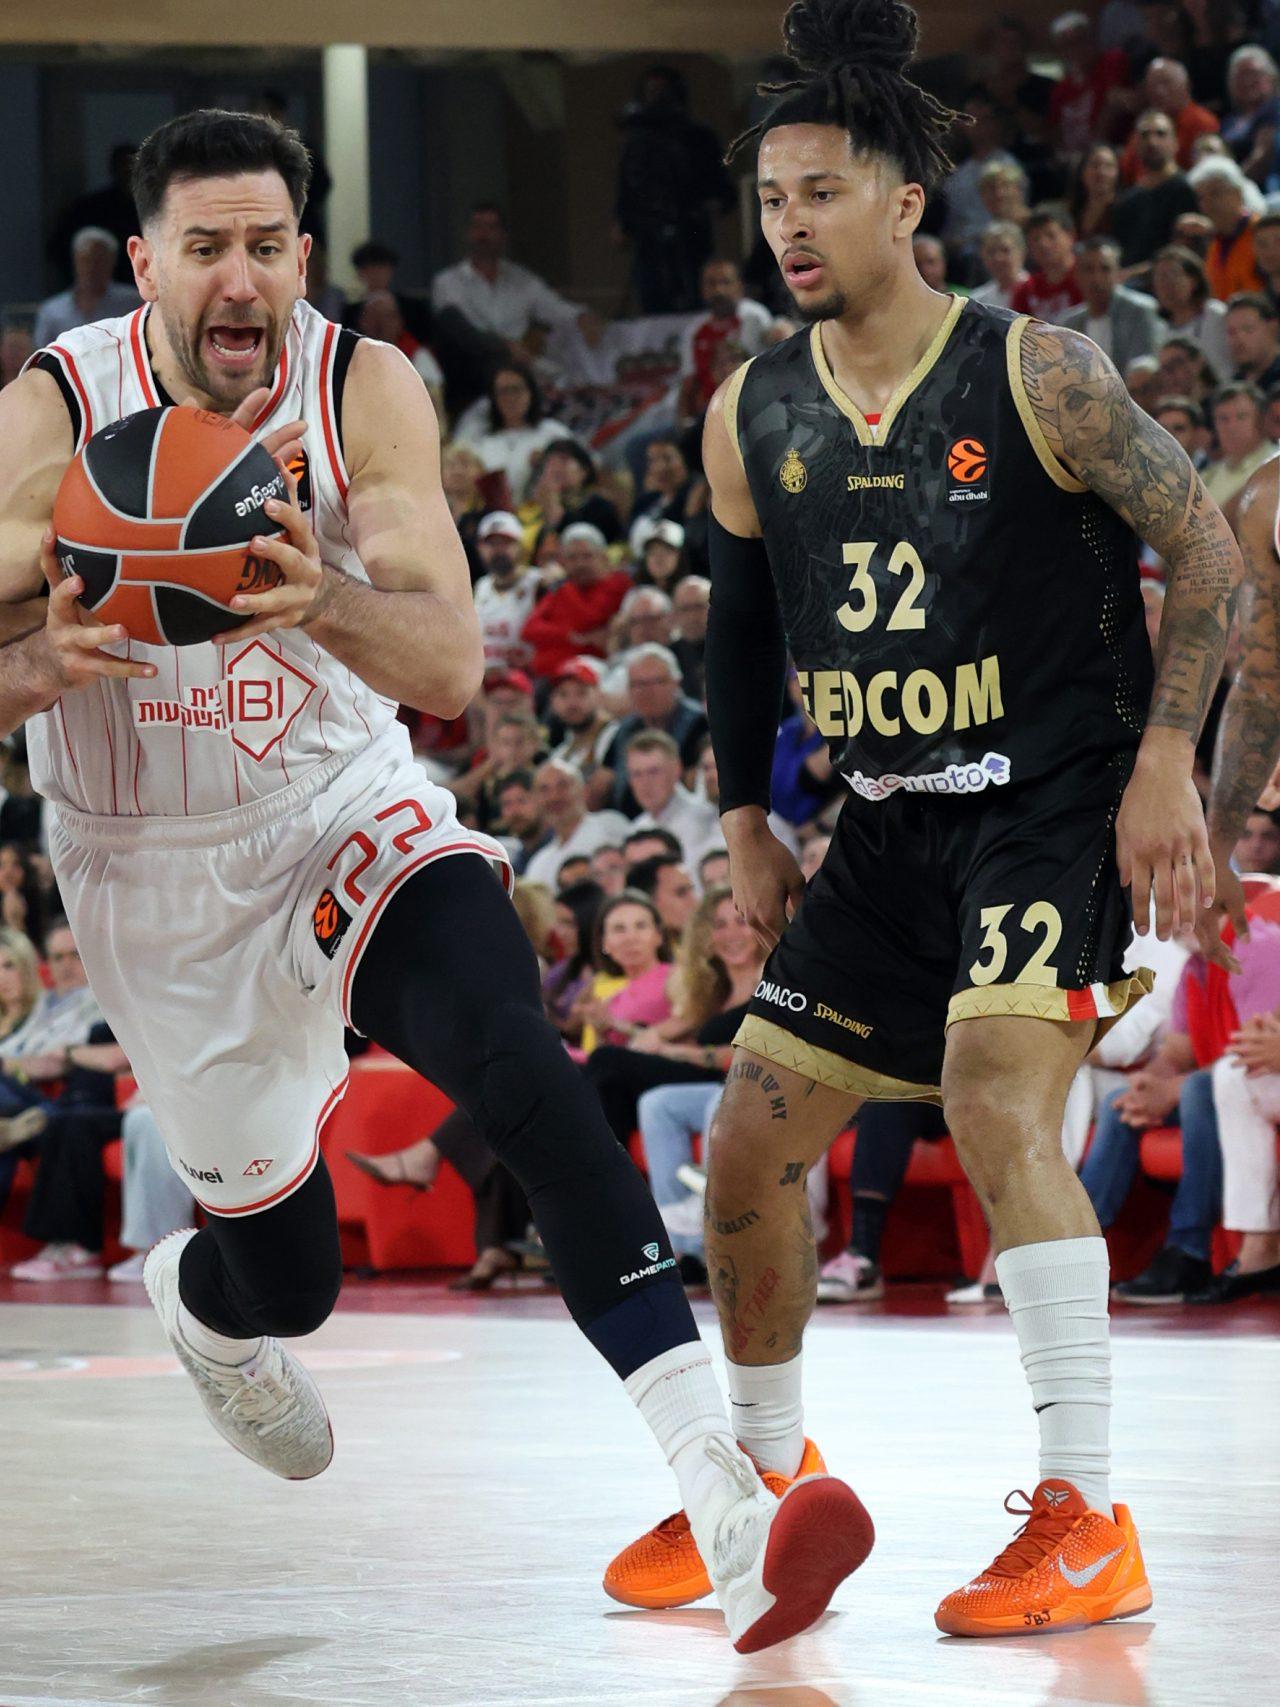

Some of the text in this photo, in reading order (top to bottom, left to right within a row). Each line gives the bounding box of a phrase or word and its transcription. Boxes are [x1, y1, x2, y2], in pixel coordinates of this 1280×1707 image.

[847, 474, 905, 491] SPALDING
[836, 541, 926, 633] 32
[227, 676, 284, 723] IBI
[326, 798, 433, 907] 22
[969, 900, 1063, 988] 32
[753, 980, 874, 1040] ONACO SPALDING
[769, 1095, 788, 1120] MY
[1023, 1609, 1051, 1626] JBJ
